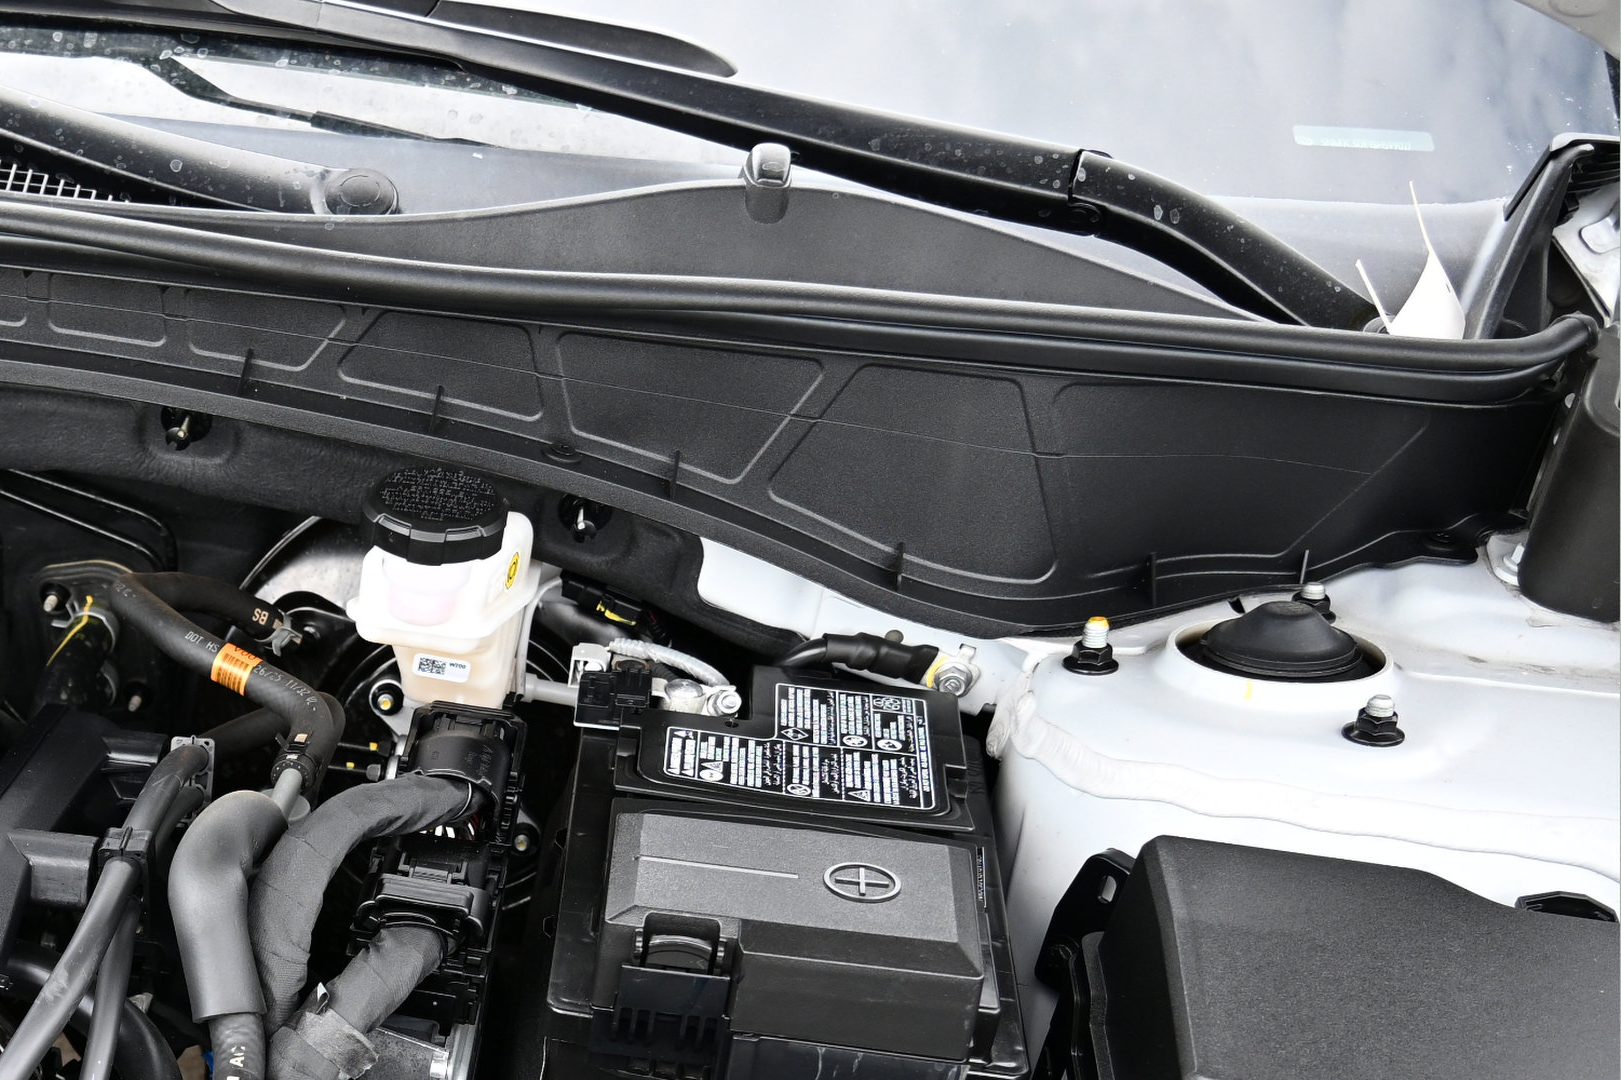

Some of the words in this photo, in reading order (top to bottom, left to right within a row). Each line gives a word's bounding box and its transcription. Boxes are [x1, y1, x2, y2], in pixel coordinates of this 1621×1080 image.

[251, 607, 270, 626] BS
[183, 630, 205, 645] DOT
[206, 641, 221, 654] HS
